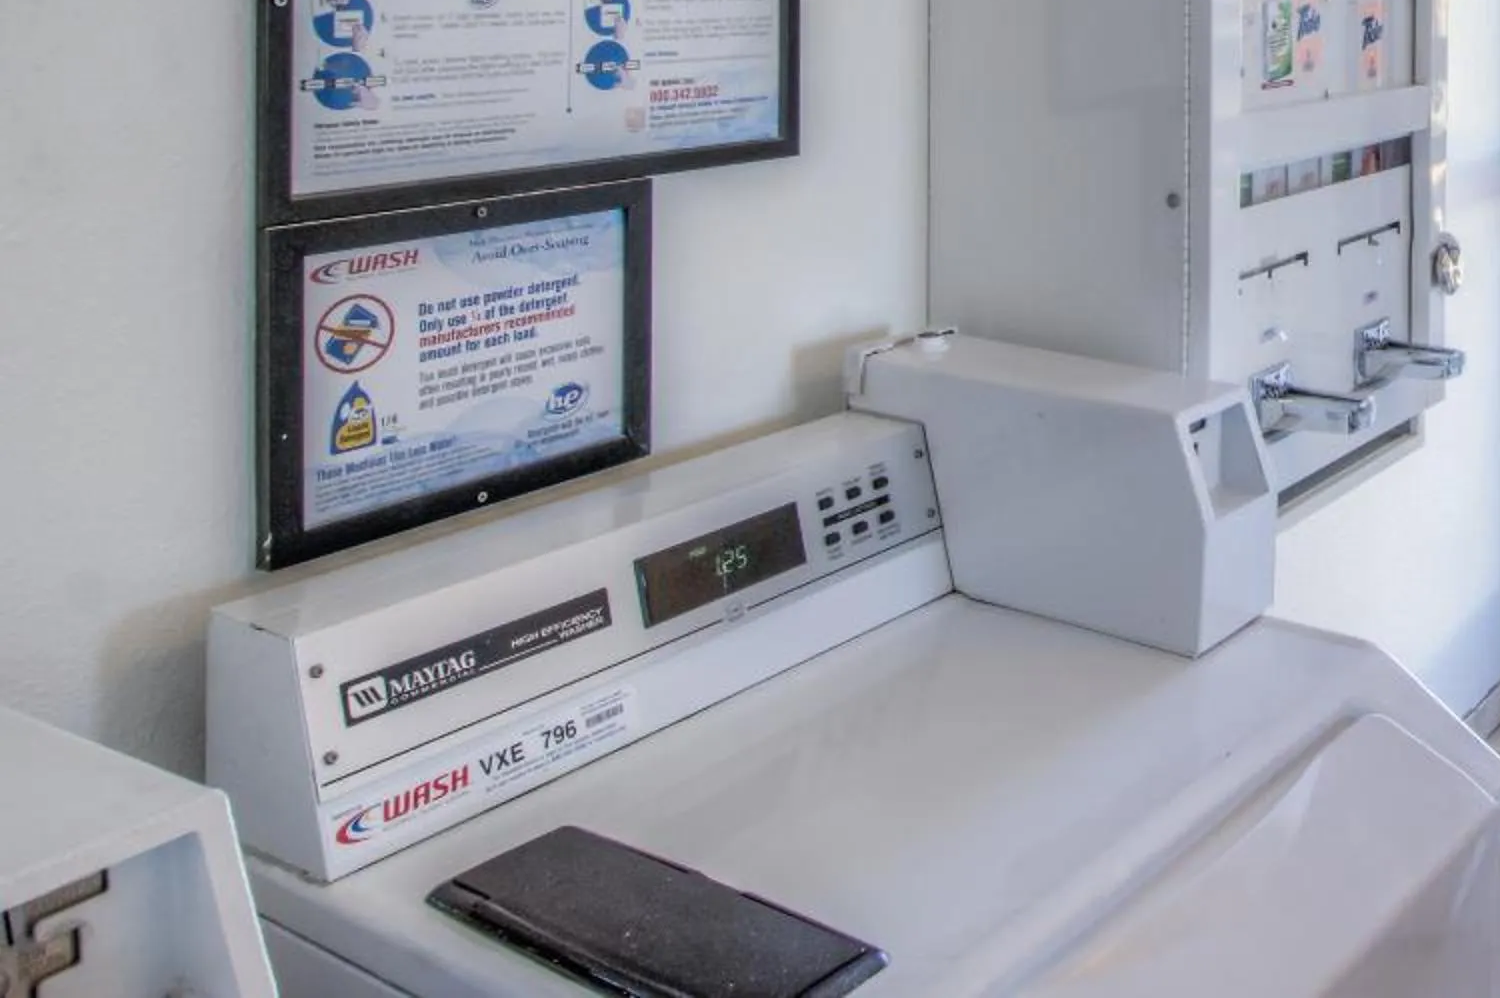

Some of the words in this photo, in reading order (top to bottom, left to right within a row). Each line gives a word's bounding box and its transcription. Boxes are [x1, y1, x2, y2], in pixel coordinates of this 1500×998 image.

[349, 248, 420, 276] WASH
[418, 302, 434, 317] Do
[437, 298, 457, 312] not
[459, 295, 480, 308] use
[483, 285, 524, 306] powder
[419, 318, 444, 334] Only
[447, 314, 467, 327] use
[484, 307, 496, 320] of
[499, 303, 515, 316] the
[419, 341, 462, 363] amount
[466, 338, 480, 351] for
[484, 332, 511, 348] each
[389, 650, 476, 699] MAYTAG
[382, 764, 470, 823] WASH
[479, 741, 526, 778] VXE
[541, 719, 577, 750] 796
